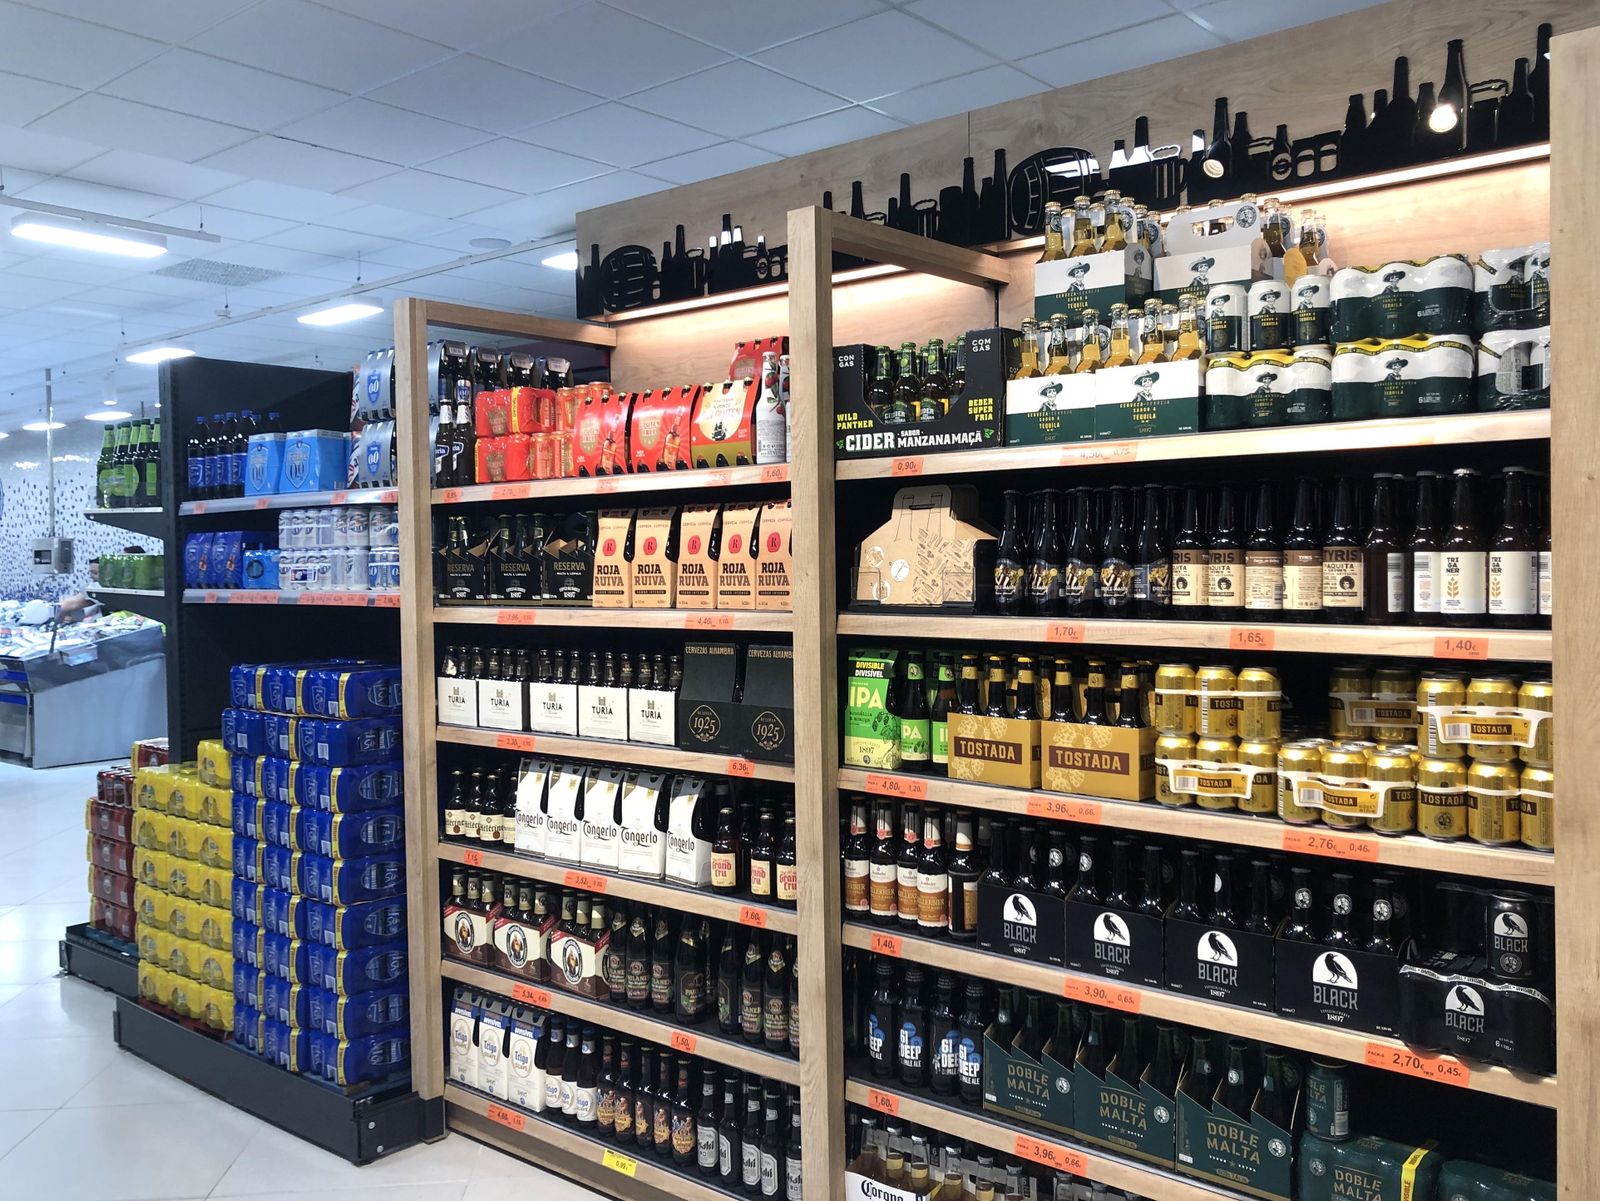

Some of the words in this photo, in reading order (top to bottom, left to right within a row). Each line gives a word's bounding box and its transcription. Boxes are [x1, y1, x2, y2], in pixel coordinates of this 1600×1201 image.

[971, 338, 991, 346] COM
[972, 344, 991, 353] GAS
[968, 398, 994, 407] BEBER
[968, 405, 994, 415] SUPER
[837, 413, 858, 421] WILD
[974, 413, 994, 422] FRIA
[1132, 413, 1156, 421] TEQUILA
[837, 420, 874, 430] PANTHER
[1039, 421, 1060, 429] TEQUILA
[900, 429, 921, 437] SABOR
[845, 432, 895, 451] CIDER
[897, 434, 951, 448] MANZANA
[951, 430, 982, 446] MAÇÃ
[1173, 552, 1191, 562] RIS
[1209, 552, 1234, 563] YRIS
[1324, 549, 1357, 562] TYRIS
[501, 563, 531, 572] RESERVA
[554, 562, 586, 571] RESERVA
[597, 565, 620, 574] ROJA
[637, 564, 662, 574] ROJA
[682, 563, 705, 574] ROJA
[722, 563, 746, 574] ROJA
[761, 562, 786, 573] ROJA
[595, 576, 624, 586] RUIVA
[634, 575, 666, 586] RUIVA
[679, 575, 709, 586] RUIVA
[719, 575, 751, 586] RUIVA
[758, 575, 790, 586] RUIVA
[685, 646, 708, 655] CERVEZAS
[748, 649, 772, 658] CERVEZAS
[773, 651, 793, 659] ALHAMB
[856, 661, 885, 669] DIVISIBLE
[855, 669, 884, 678] DIVISÍVEL
[448, 695, 465, 704] TURIA
[491, 698, 509, 707] TURIA
[849, 686, 884, 710] IPA
[543, 702, 563, 711] TURIA
[592, 706, 613, 715] TURIA
[641, 709, 661, 720] TURIA
[694, 717, 716, 734] 1925
[1473, 725, 1508, 734] TOSTADA
[756, 723, 779, 742] 1925
[902, 724, 922, 740] PA
[959, 740, 1016, 761] TOSTADA
[1056, 749, 1121, 771] TOSTADA
[1200, 779, 1228, 787] TOSTADA
[1324, 794, 1354, 805] TOSTADA
[1423, 793, 1465, 806] TOSTADA
[515, 809, 543, 829] Tongerlo
[547, 815, 577, 835] Tongerlo
[583, 820, 617, 841] Tongerlo
[620, 826, 658, 848] Tongerlo
[667, 830, 695, 854] Tongerlo
[714, 870, 727, 878] Cru
[752, 868, 765, 878] rand
[779, 873, 796, 885] Gran
[1003, 922, 1037, 944] BLACK
[1494, 937, 1528, 952] BLACK
[1094, 942, 1131, 965] BLACK
[1198, 962, 1238, 987] BLACK
[1313, 984, 1359, 1011] BLACK
[1445, 1011, 1485, 1034] BLACK
[455, 1030, 468, 1042] Trigo
[900, 1029, 909, 1043] 61
[484, 1041, 497, 1053] Trigo
[870, 1037, 883, 1052] EEP
[941, 1039, 953, 1053] 61
[514, 1051, 529, 1065] Trigo
[900, 1045, 922, 1060] DEEP
[959, 1045, 967, 1061] 61
[913, 1060, 922, 1068] ALE
[941, 1053, 958, 1068] DEE
[959, 1060, 980, 1078] DEEP
[1008, 1064, 1049, 1084] DOBLE
[972, 1077, 980, 1085] ALE
[1007, 1077, 1050, 1101] MALTA
[1101, 1091, 1147, 1115] DOBLE
[1309, 1093, 1327, 1104] LTA
[1100, 1105, 1147, 1131] MALTA
[1207, 1122, 1259, 1149] DOBLE
[1206, 1138, 1261, 1165] MALTA
[787, 1171, 802, 1184] Asah
[1334, 1169, 1382, 1191] DOBLE
[1334, 1182, 1382, 1201] MALTA
